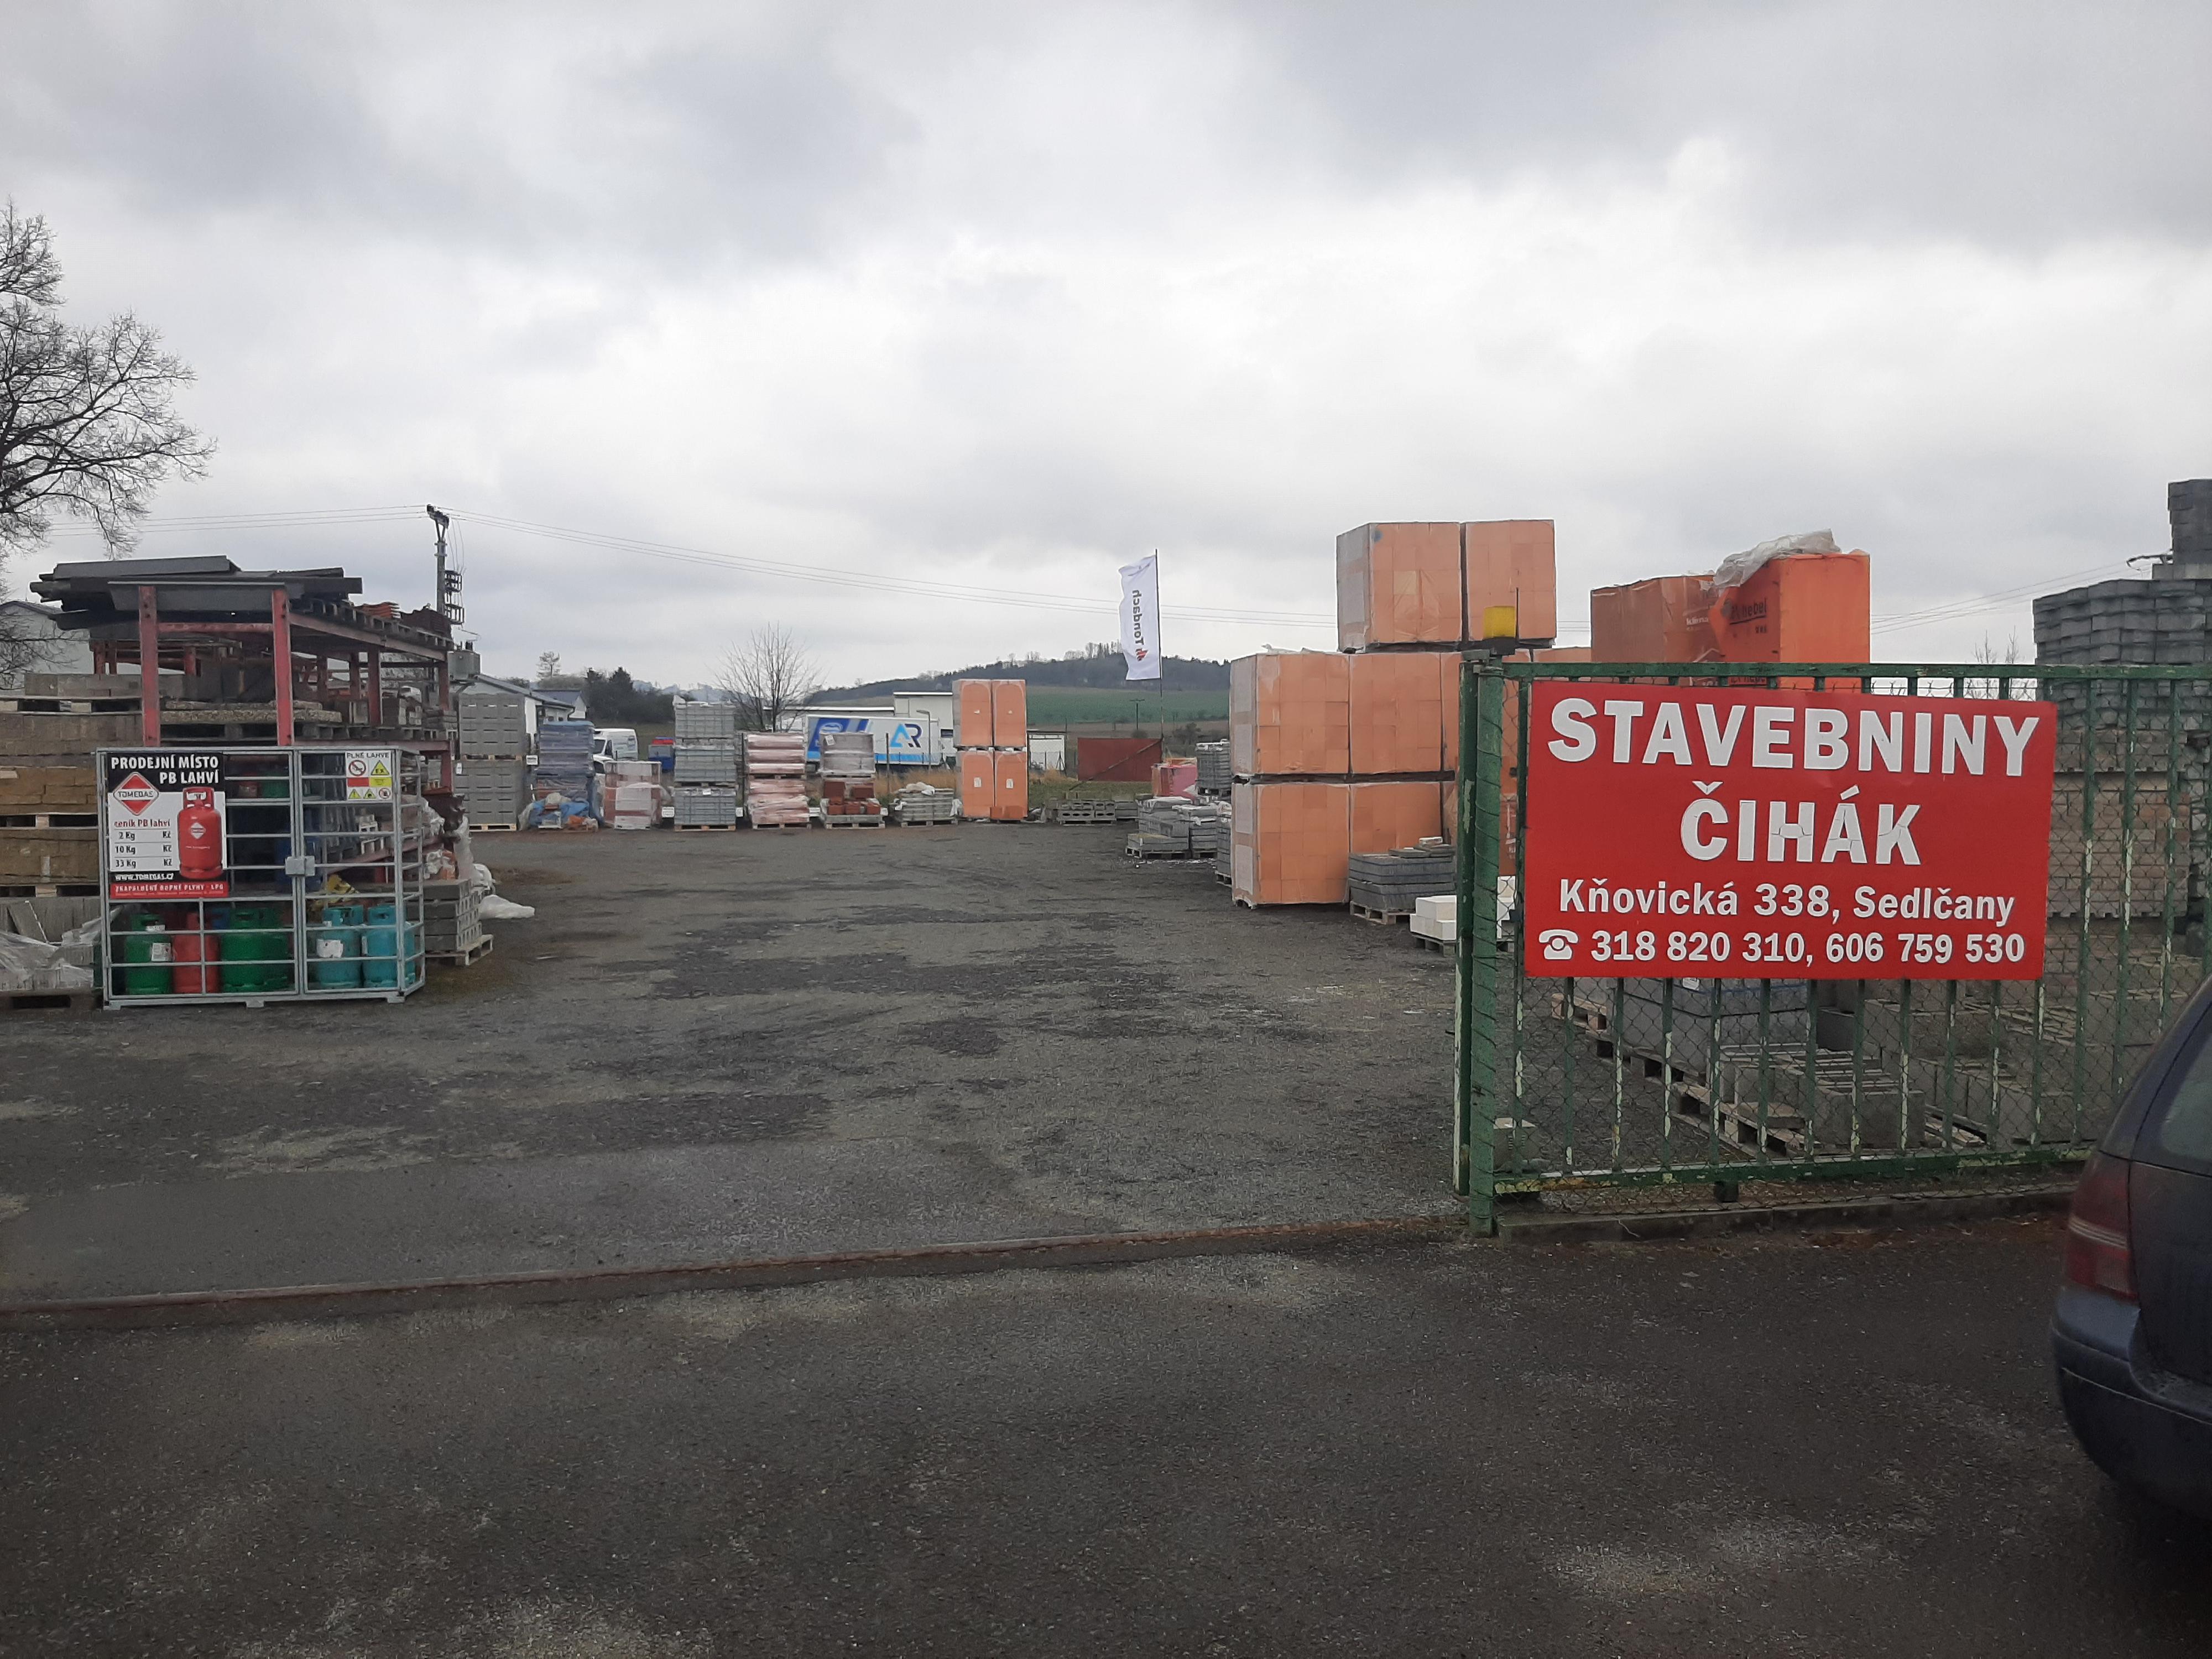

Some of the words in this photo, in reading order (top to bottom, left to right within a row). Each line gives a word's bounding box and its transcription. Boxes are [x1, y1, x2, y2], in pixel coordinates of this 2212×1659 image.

[1547, 698, 2040, 776] STAVEBNINY
[111, 754, 176, 769] PRODEJNÍ
[178, 754, 218, 769] MÍSTO
[159, 772, 177, 784] PB
[181, 769, 219, 784] LAHVÍ
[114, 818, 135, 827] ceník
[138, 819, 148, 827] PB
[150, 818, 170, 827] lahví
[1680, 781, 1921, 865] ČIHÁK
[119, 831, 123, 839] 2
[126, 831, 135, 841] Kg
[126, 846, 136, 855] Kg
[127, 859, 137, 869] Kg
[1560, 878, 1738, 915] Kňovická
[1754, 883, 1840, 925] 338,
[1853, 885, 2015, 927] Sedlčany
[1590, 930, 1656, 961] 318
[1667, 931, 1730, 961] 820
[1742, 932, 1813, 967] 310,
[1826, 932, 1884, 963] 606
[1897, 933, 1953, 964] 759
[1965, 933, 2025, 963] 530
